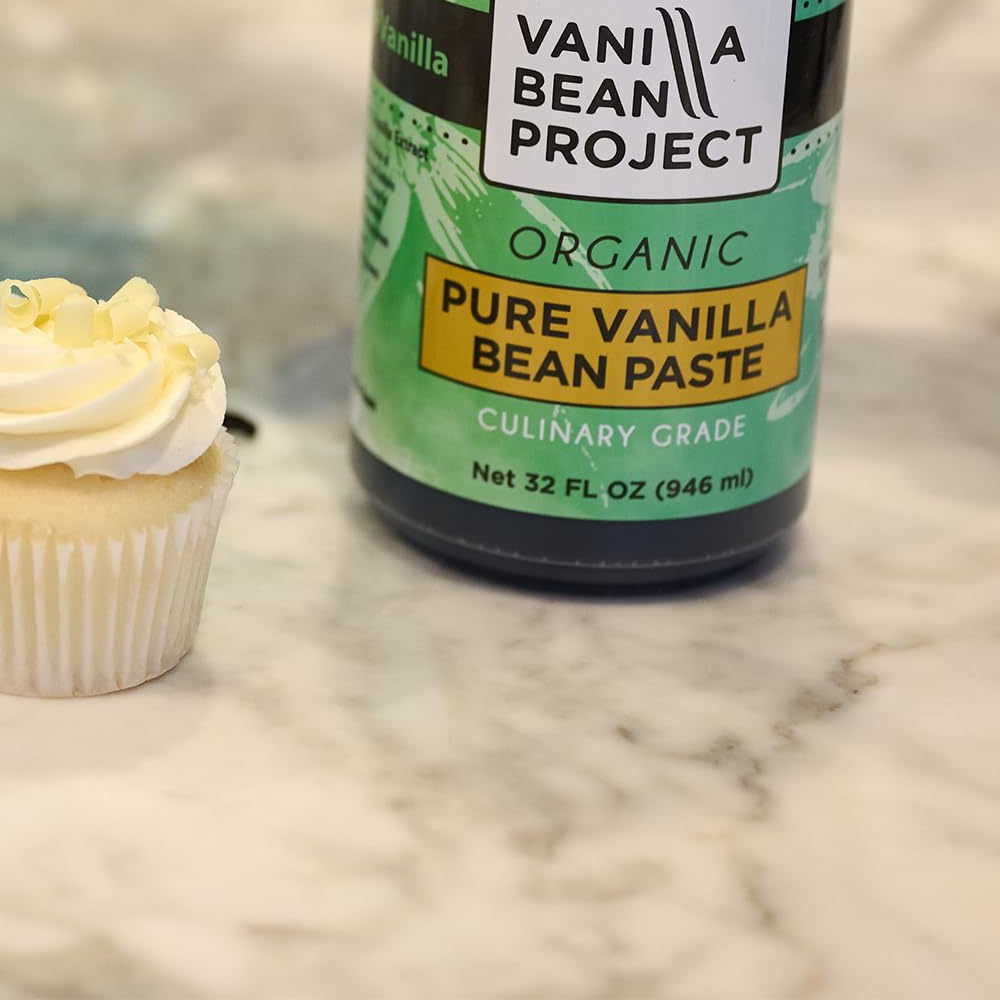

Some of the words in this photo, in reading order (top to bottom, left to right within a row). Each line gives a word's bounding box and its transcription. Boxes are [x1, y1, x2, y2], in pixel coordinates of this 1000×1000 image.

[513, 67, 670, 119] BEAN
[509, 119, 763, 171] PROJECT
[508, 225, 750, 272] ORGANIC
[440, 278, 572, 340] PURE
[592, 289, 794, 345] VANILLA
[471, 335, 607, 391] BEAN
[624, 343, 766, 392] PASTE
[477, 406, 637, 449] CULINARY
[651, 414, 748, 449] GRADE
[472, 460, 516, 487] Net
[524, 472, 557, 496] 32
[564, 477, 598, 500] FL
[607, 480, 647, 501] OZ
[655, 475, 714, 503] (946
[720, 467, 755, 494] ml)
